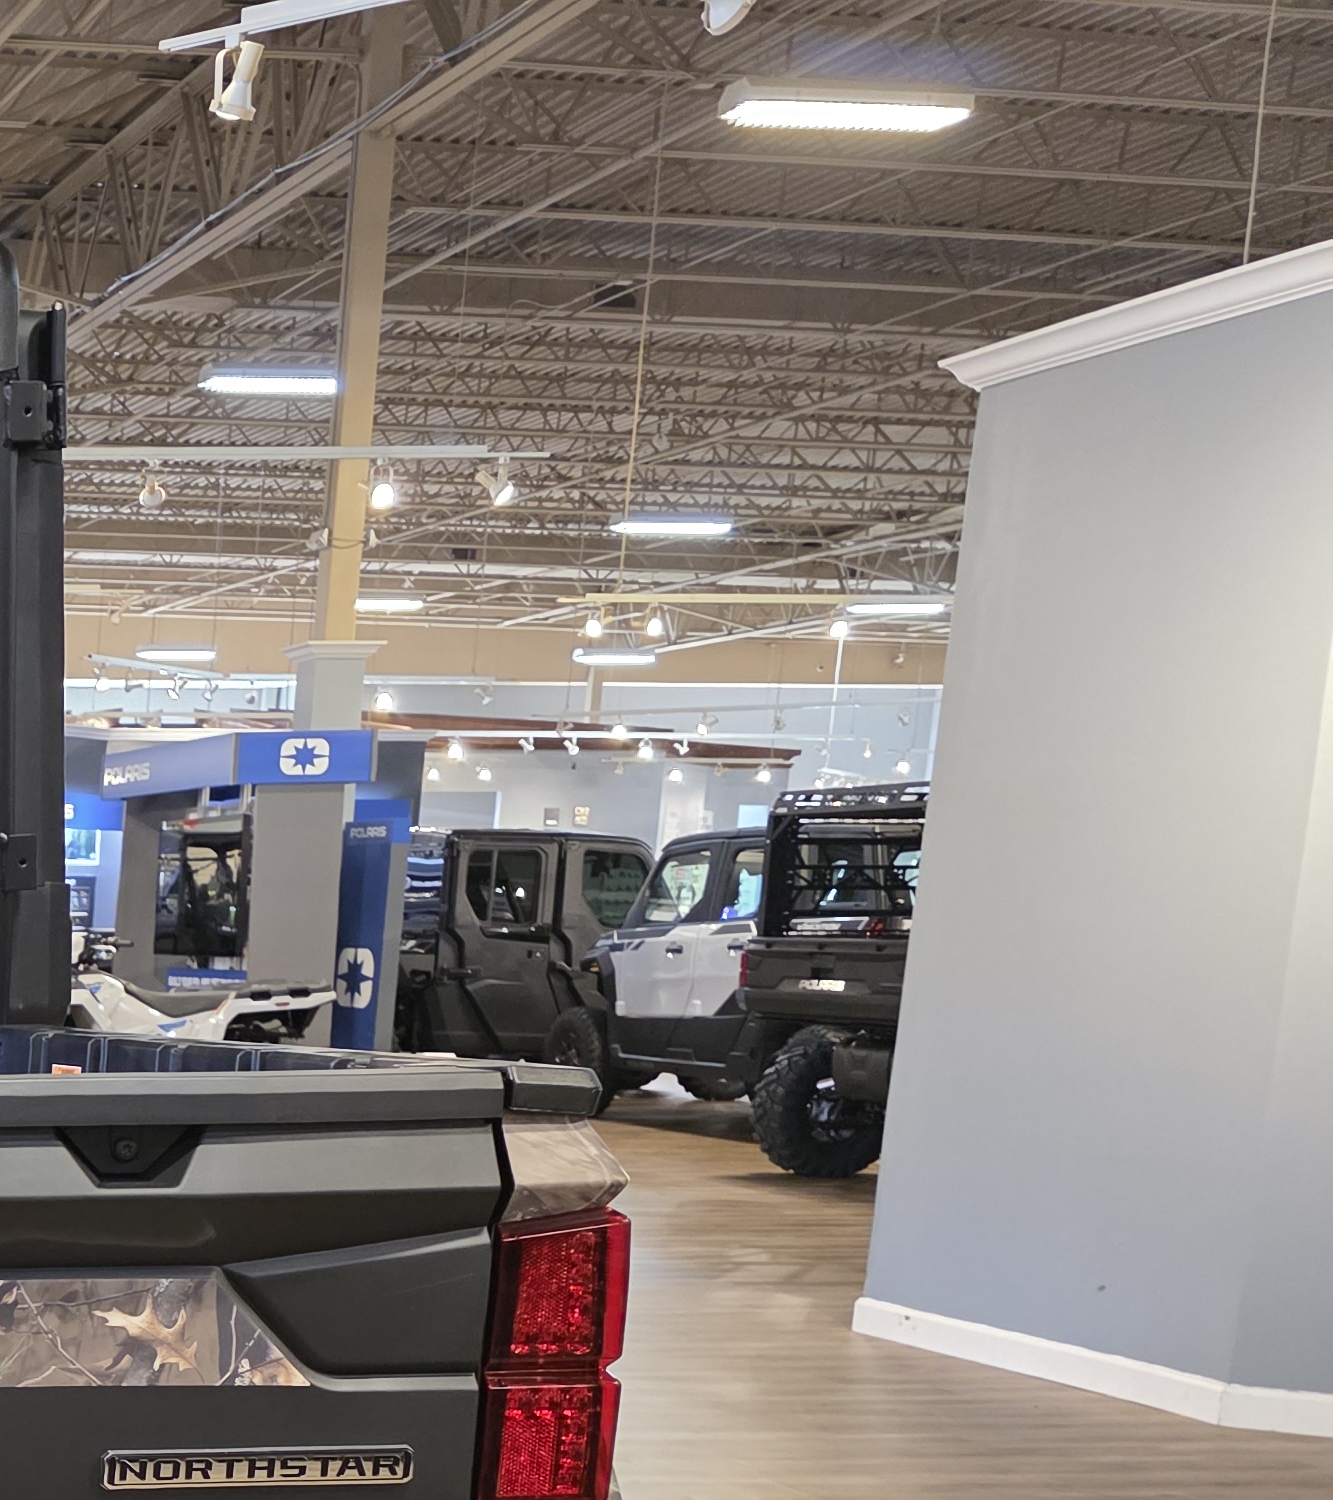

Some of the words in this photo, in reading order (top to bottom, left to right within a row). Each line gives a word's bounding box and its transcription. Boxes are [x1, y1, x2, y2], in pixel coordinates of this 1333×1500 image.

[103, 762, 150, 787] POLARIS
[349, 825, 388, 840] POLARIS
[798, 980, 846, 992] POLARIS
[117, 1453, 402, 1482] NORTHSTAR
